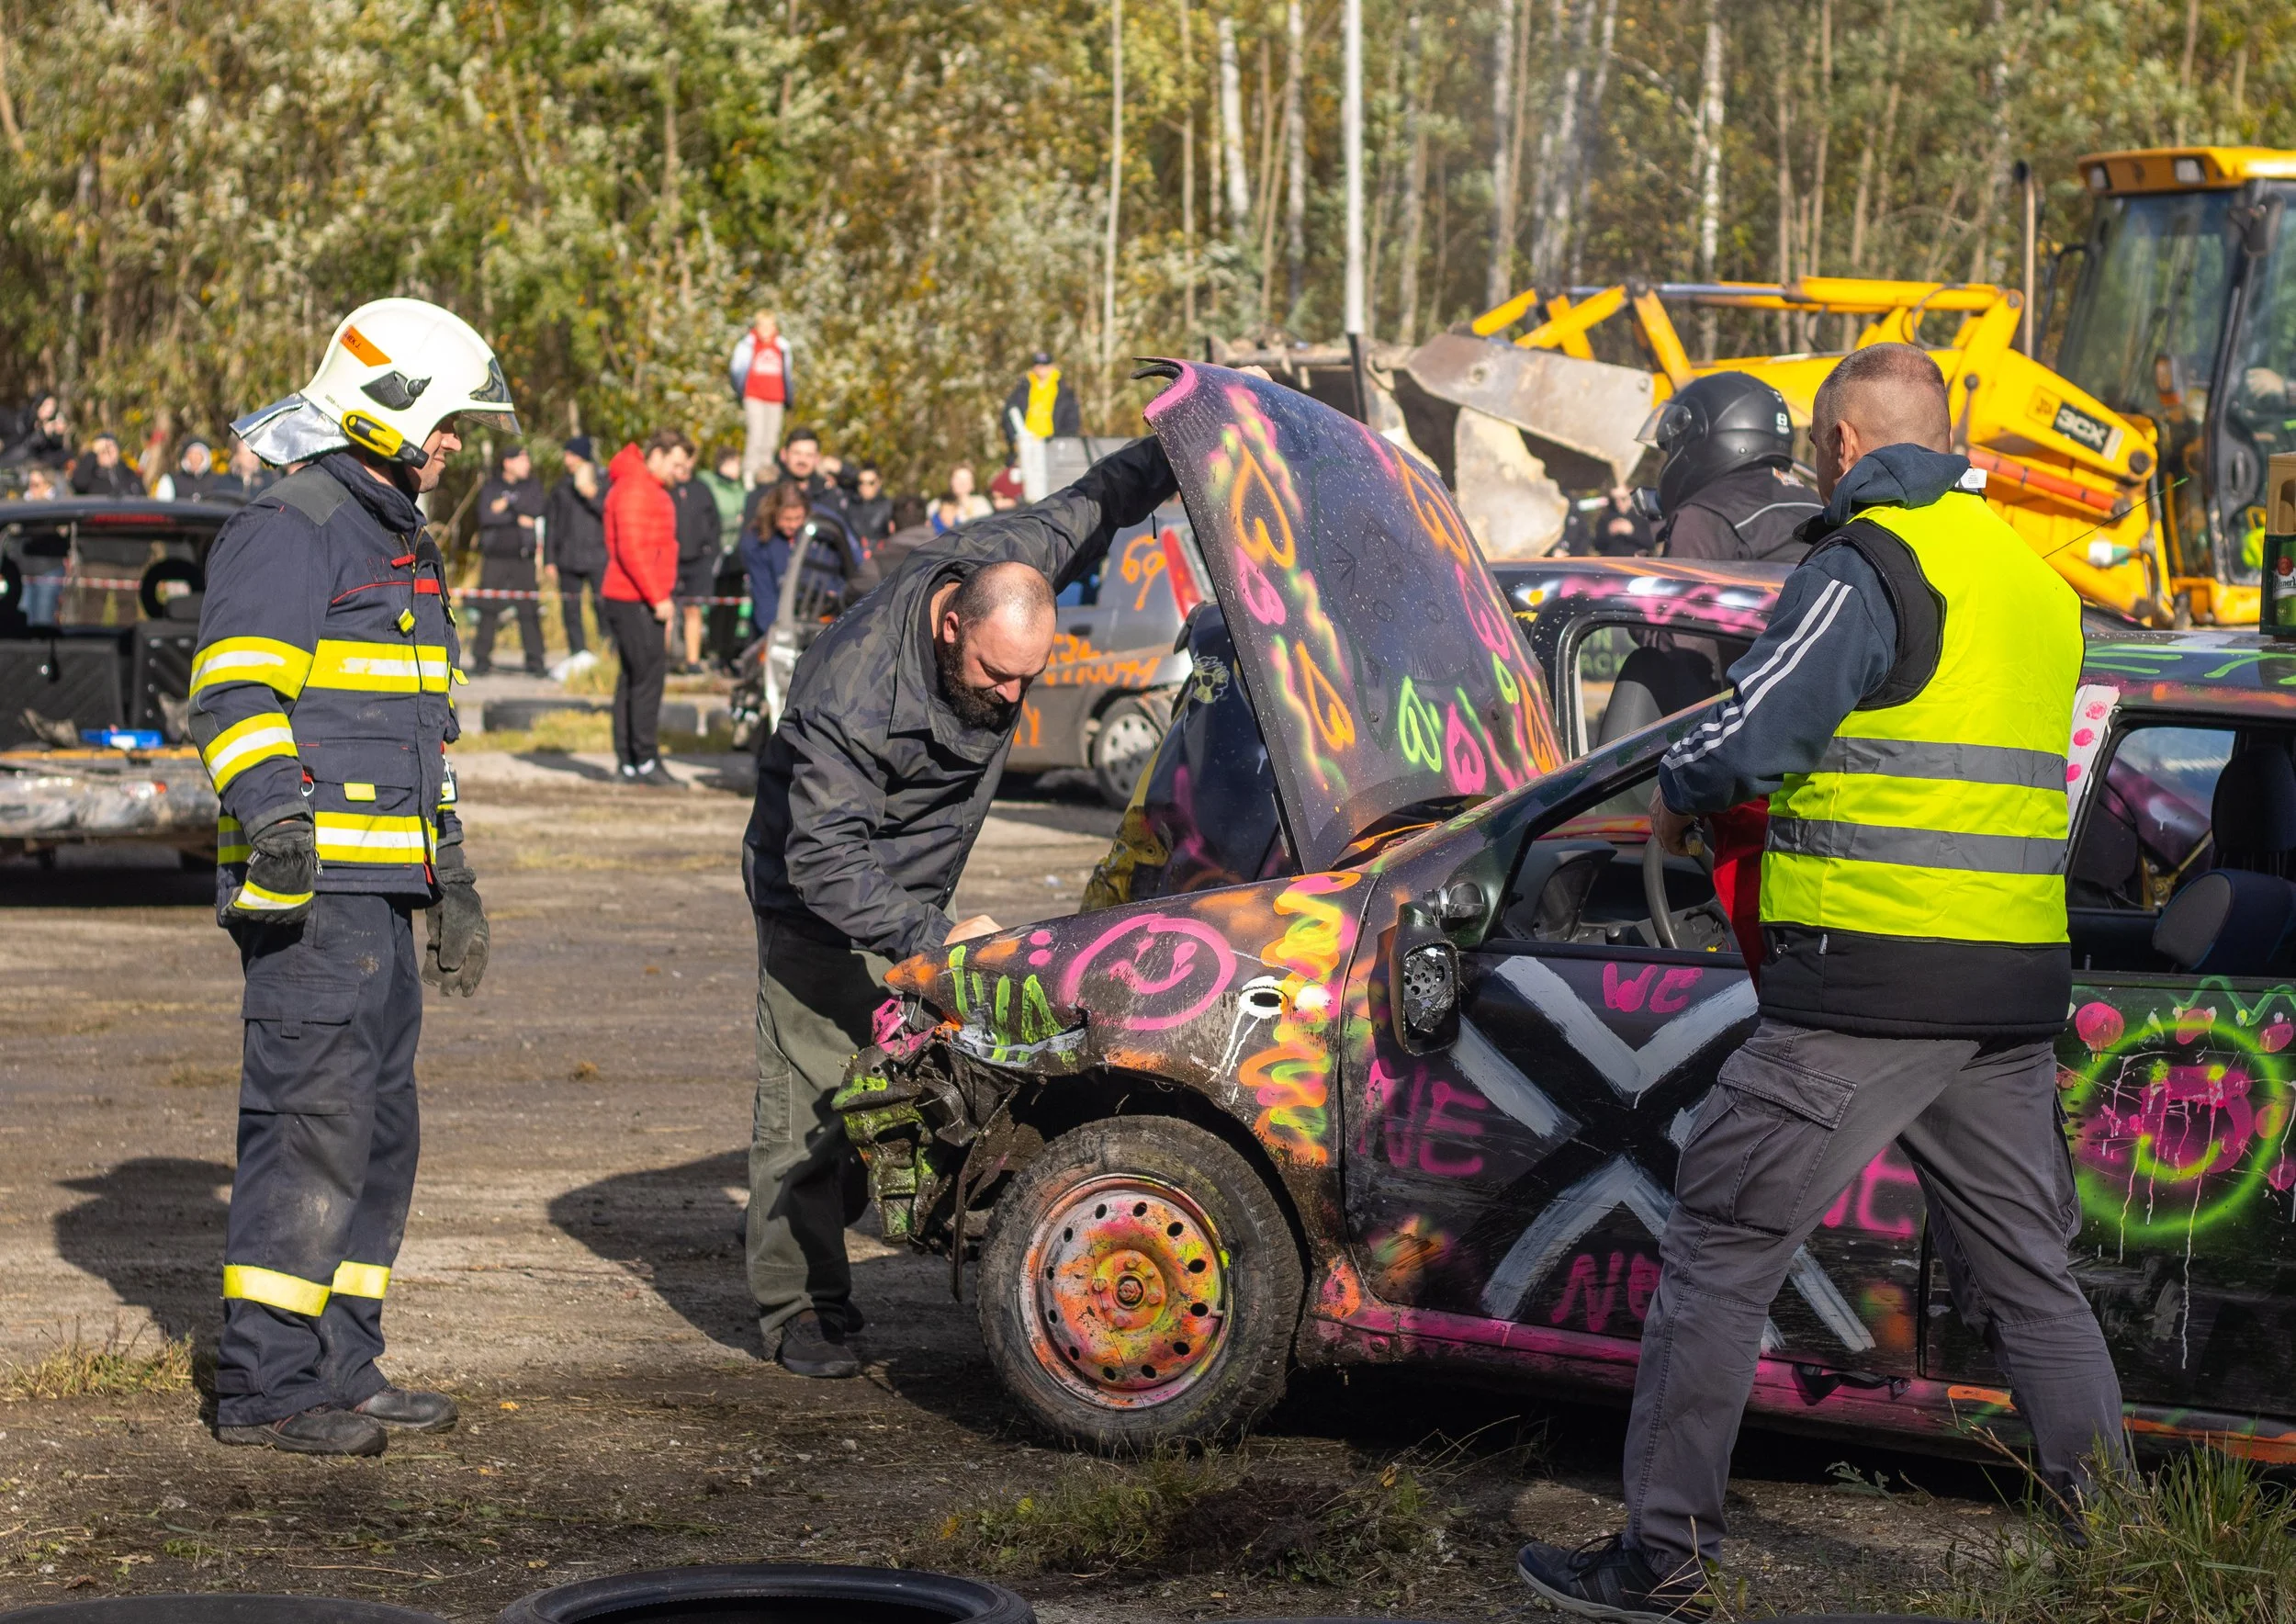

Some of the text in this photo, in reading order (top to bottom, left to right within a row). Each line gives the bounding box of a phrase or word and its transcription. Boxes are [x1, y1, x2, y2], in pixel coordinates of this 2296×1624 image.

[2056, 407, 2109, 449] 3CX
[1120, 533, 1166, 611] 69
[1358, 1059, 1488, 1177] NE
